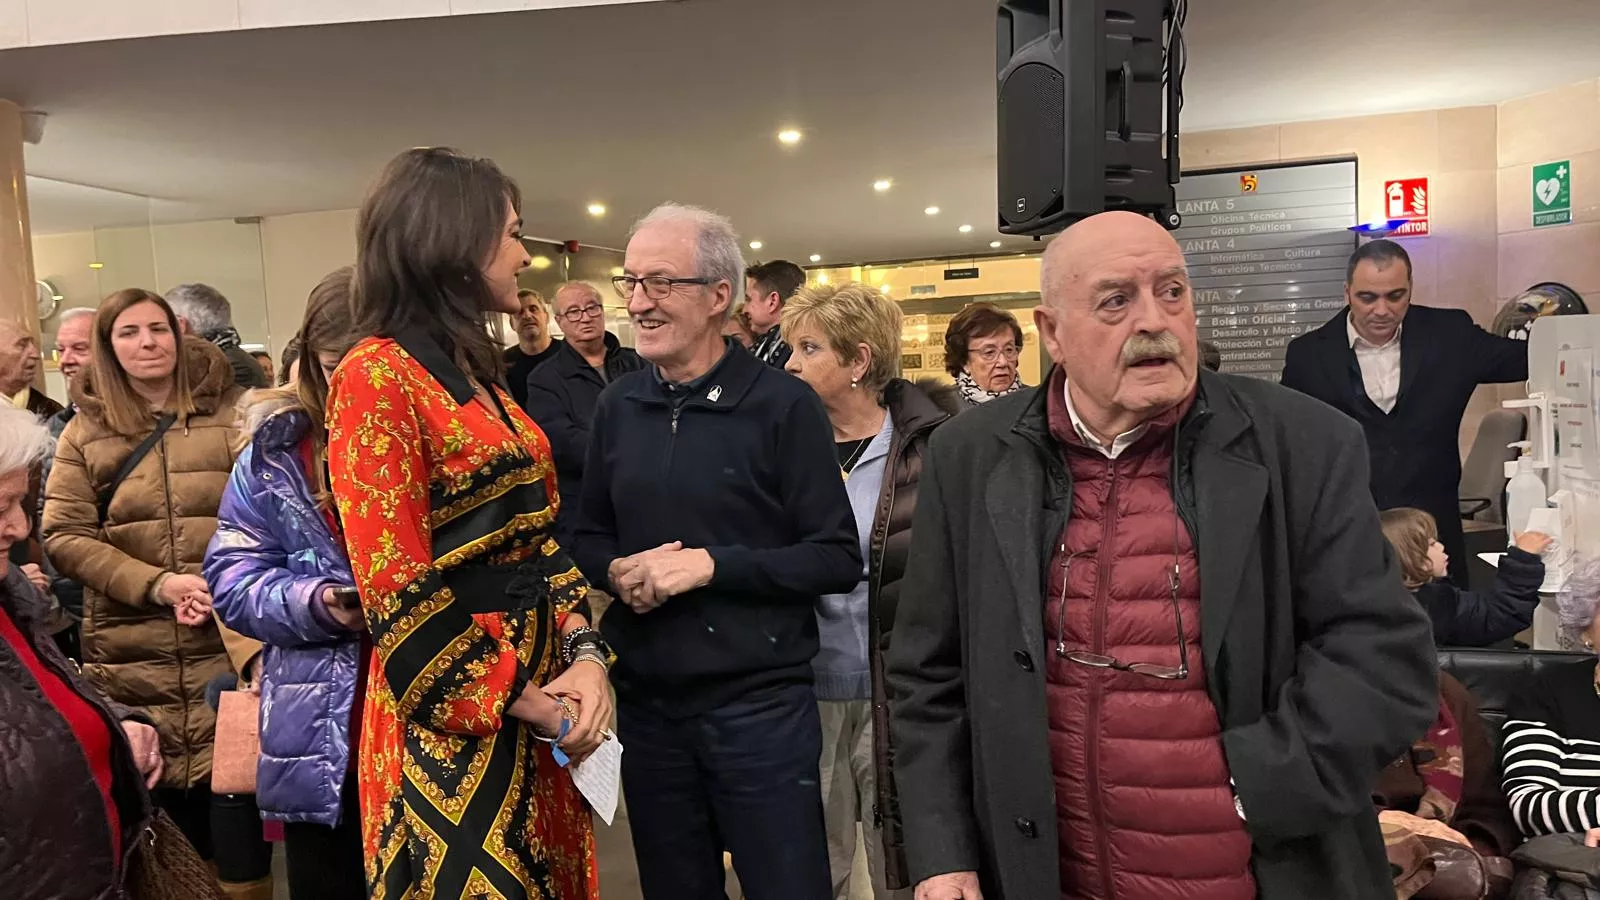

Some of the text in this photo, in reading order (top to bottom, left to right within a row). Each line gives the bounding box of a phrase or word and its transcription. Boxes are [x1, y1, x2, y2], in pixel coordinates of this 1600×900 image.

[1177, 199, 1235, 213] LANTA 5
[1211, 215, 1244, 224] Oficina
[1211, 226, 1245, 236] Grupos
[1397, 222, 1427, 234] TINTOR
[1185, 238, 1235, 252] ANTA 4
[1284, 248, 1320, 258] Cultura
[1211, 264, 1254, 275] Servicios
[1195, 290, 1221, 302] NTA
[1212, 303, 1249, 315] Registro
[1253, 303, 1260, 312] y
[1252, 313, 1286, 324] Oficial
[1212, 327, 1260, 338] Desarrollo
[1263, 328, 1269, 337] y
[1273, 325, 1301, 335] Medio
[1265, 337, 1285, 347] Civil
[1220, 349, 1272, 361] ontratación
